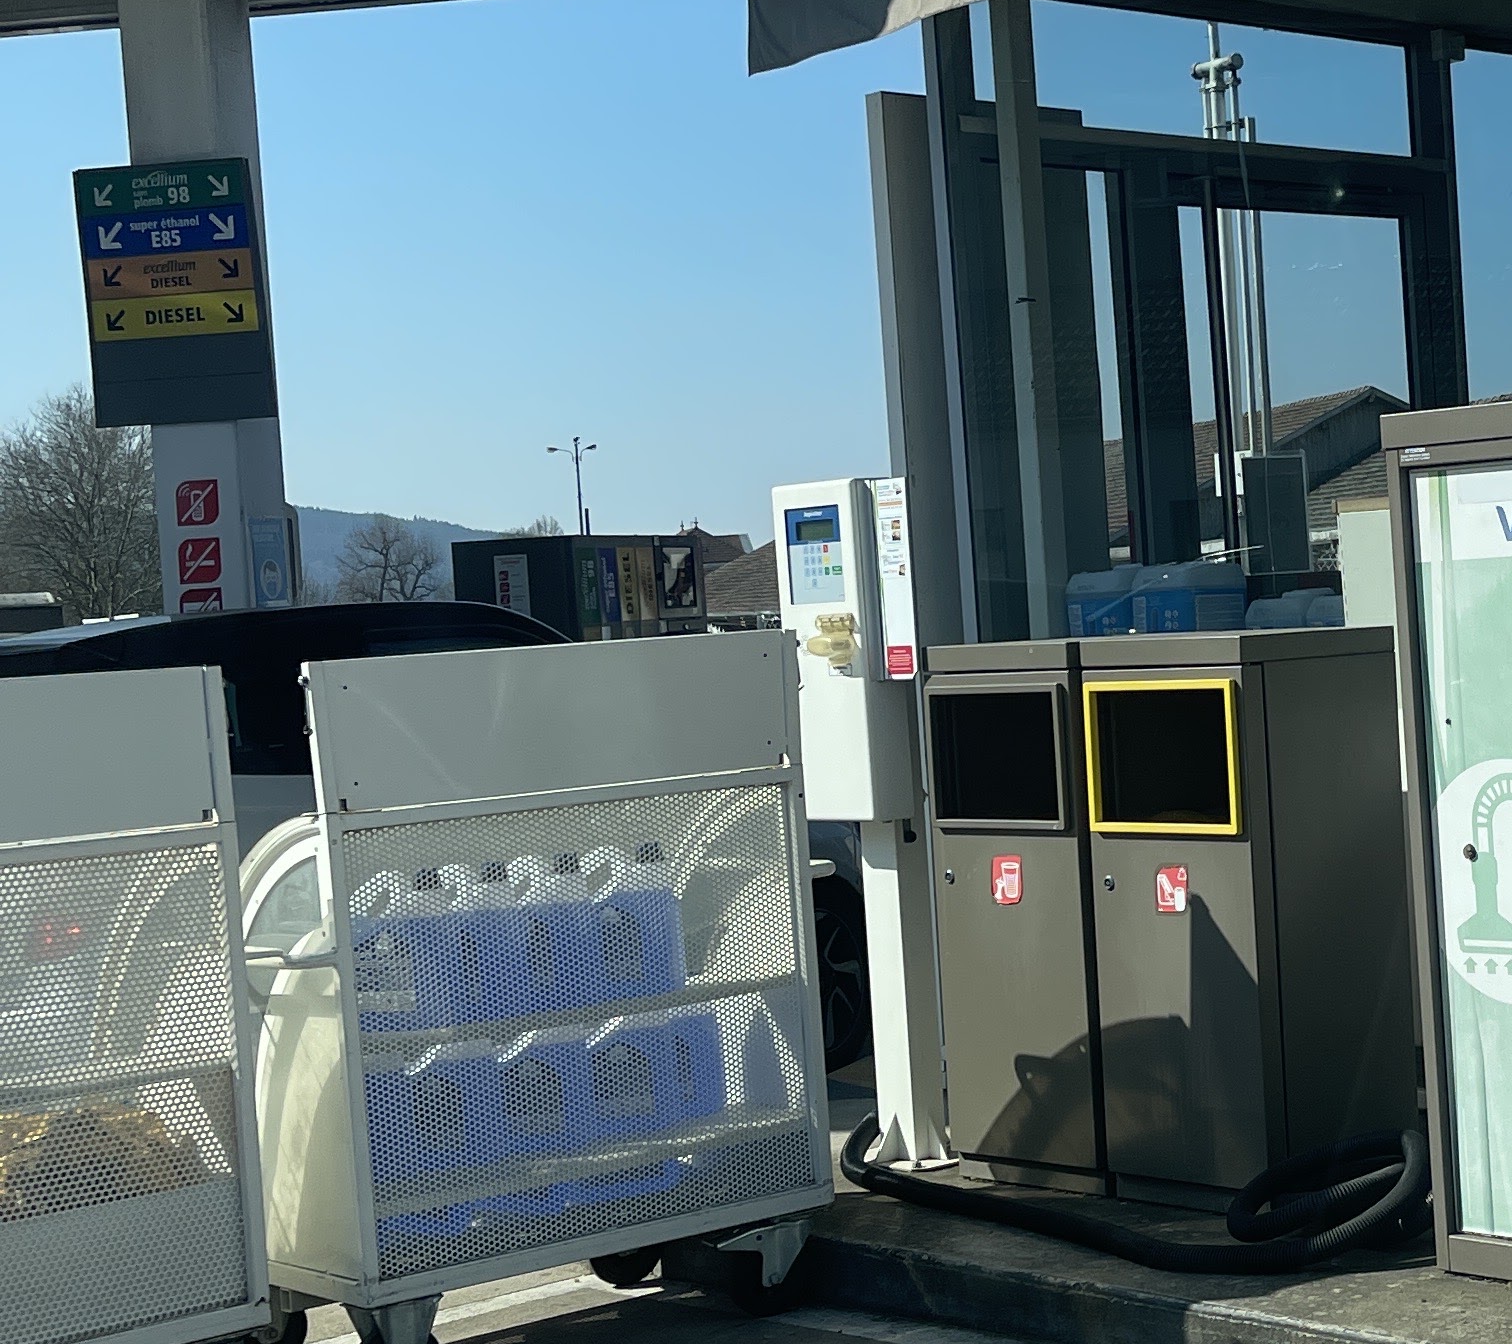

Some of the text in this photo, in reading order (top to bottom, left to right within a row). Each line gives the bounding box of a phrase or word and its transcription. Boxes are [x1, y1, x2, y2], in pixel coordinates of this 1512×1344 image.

[131, 172, 188, 189] excellium
[133, 185, 190, 210] plomb 98
[129, 214, 200, 234] super éthanol
[150, 229, 182, 248] E85
[143, 259, 196, 275] excellium
[150, 275, 192, 289] DIESEL
[145, 306, 206, 325] DIESEL
[621, 551, 634, 615] DIESEL
